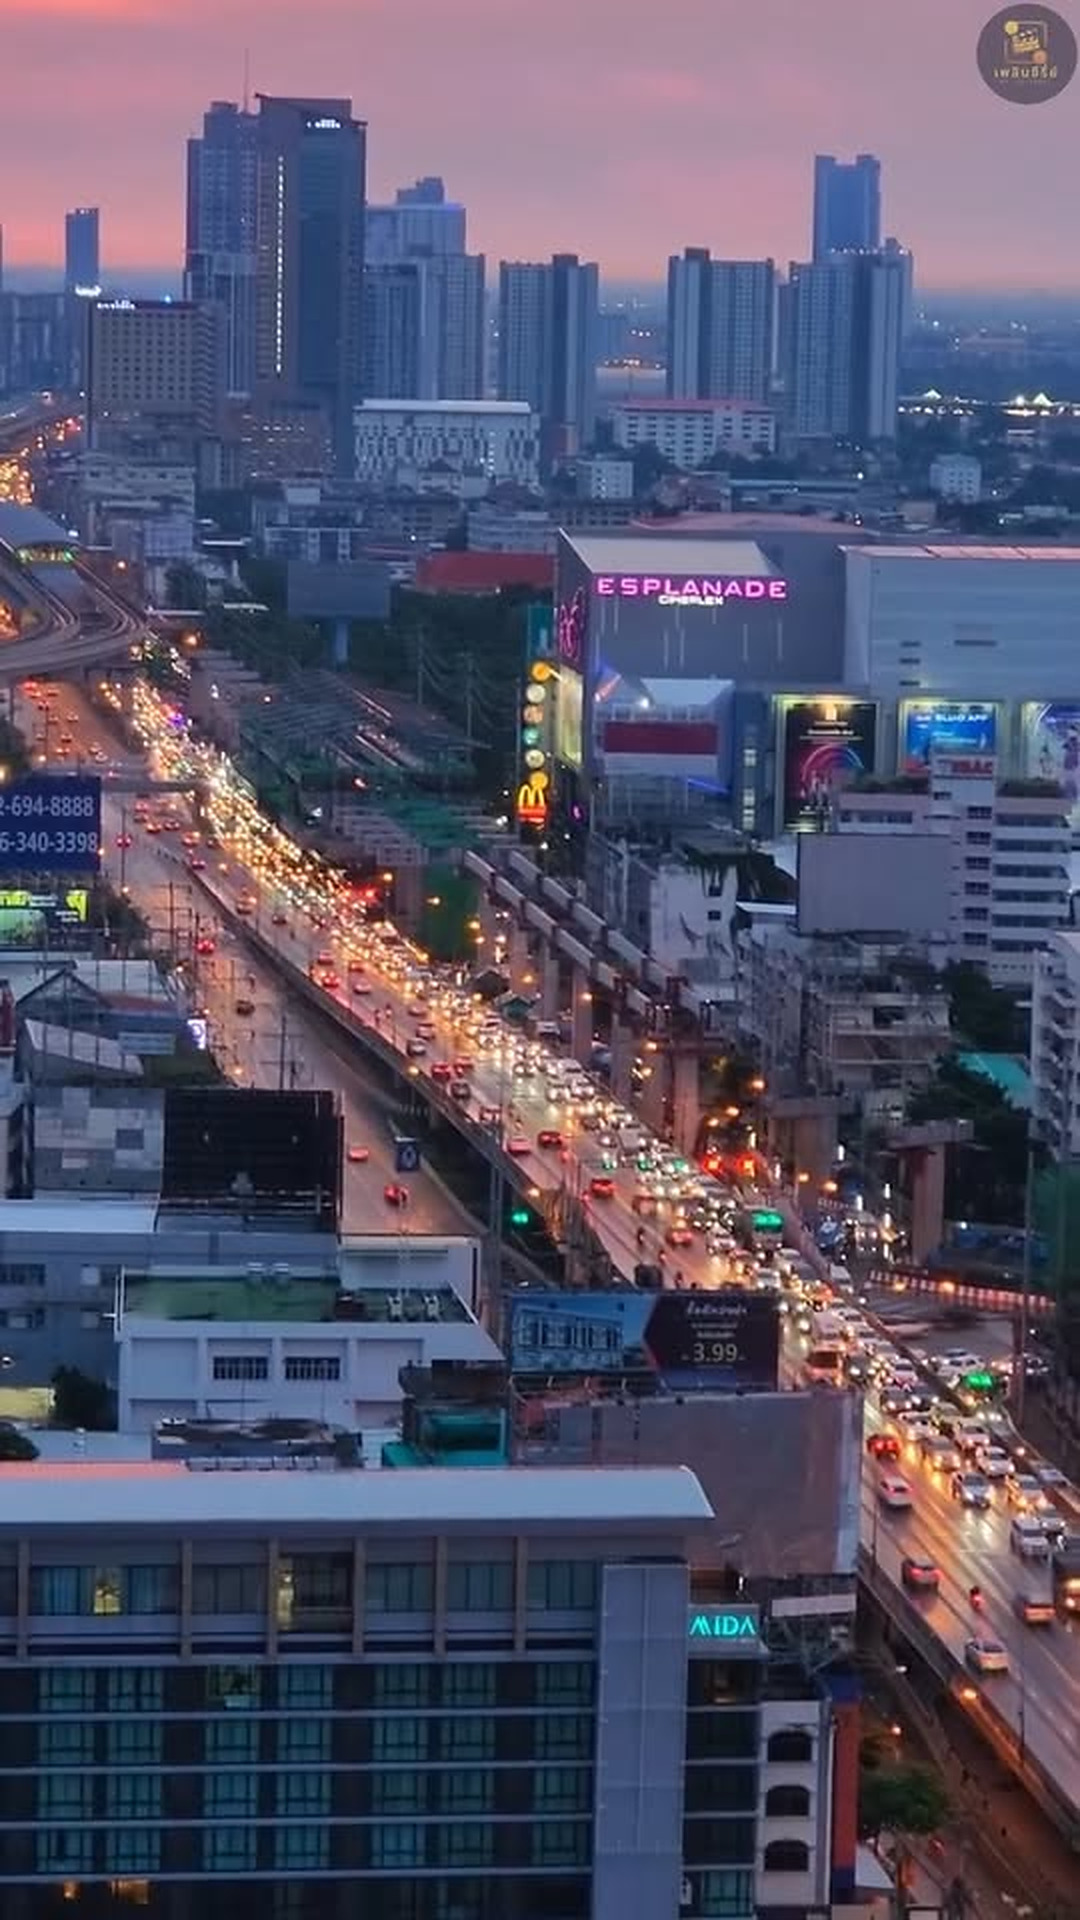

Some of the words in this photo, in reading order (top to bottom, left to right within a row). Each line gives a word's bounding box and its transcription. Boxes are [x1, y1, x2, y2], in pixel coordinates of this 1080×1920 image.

[597, 578, 787, 599] ESPLANADE
[658, 594, 725, 606] CINEPLEX
[0, 832, 97, 853] 6-340-3398
[693, 1343, 738, 1362] 3.99
[689, 1615, 756, 1636] MIDA
